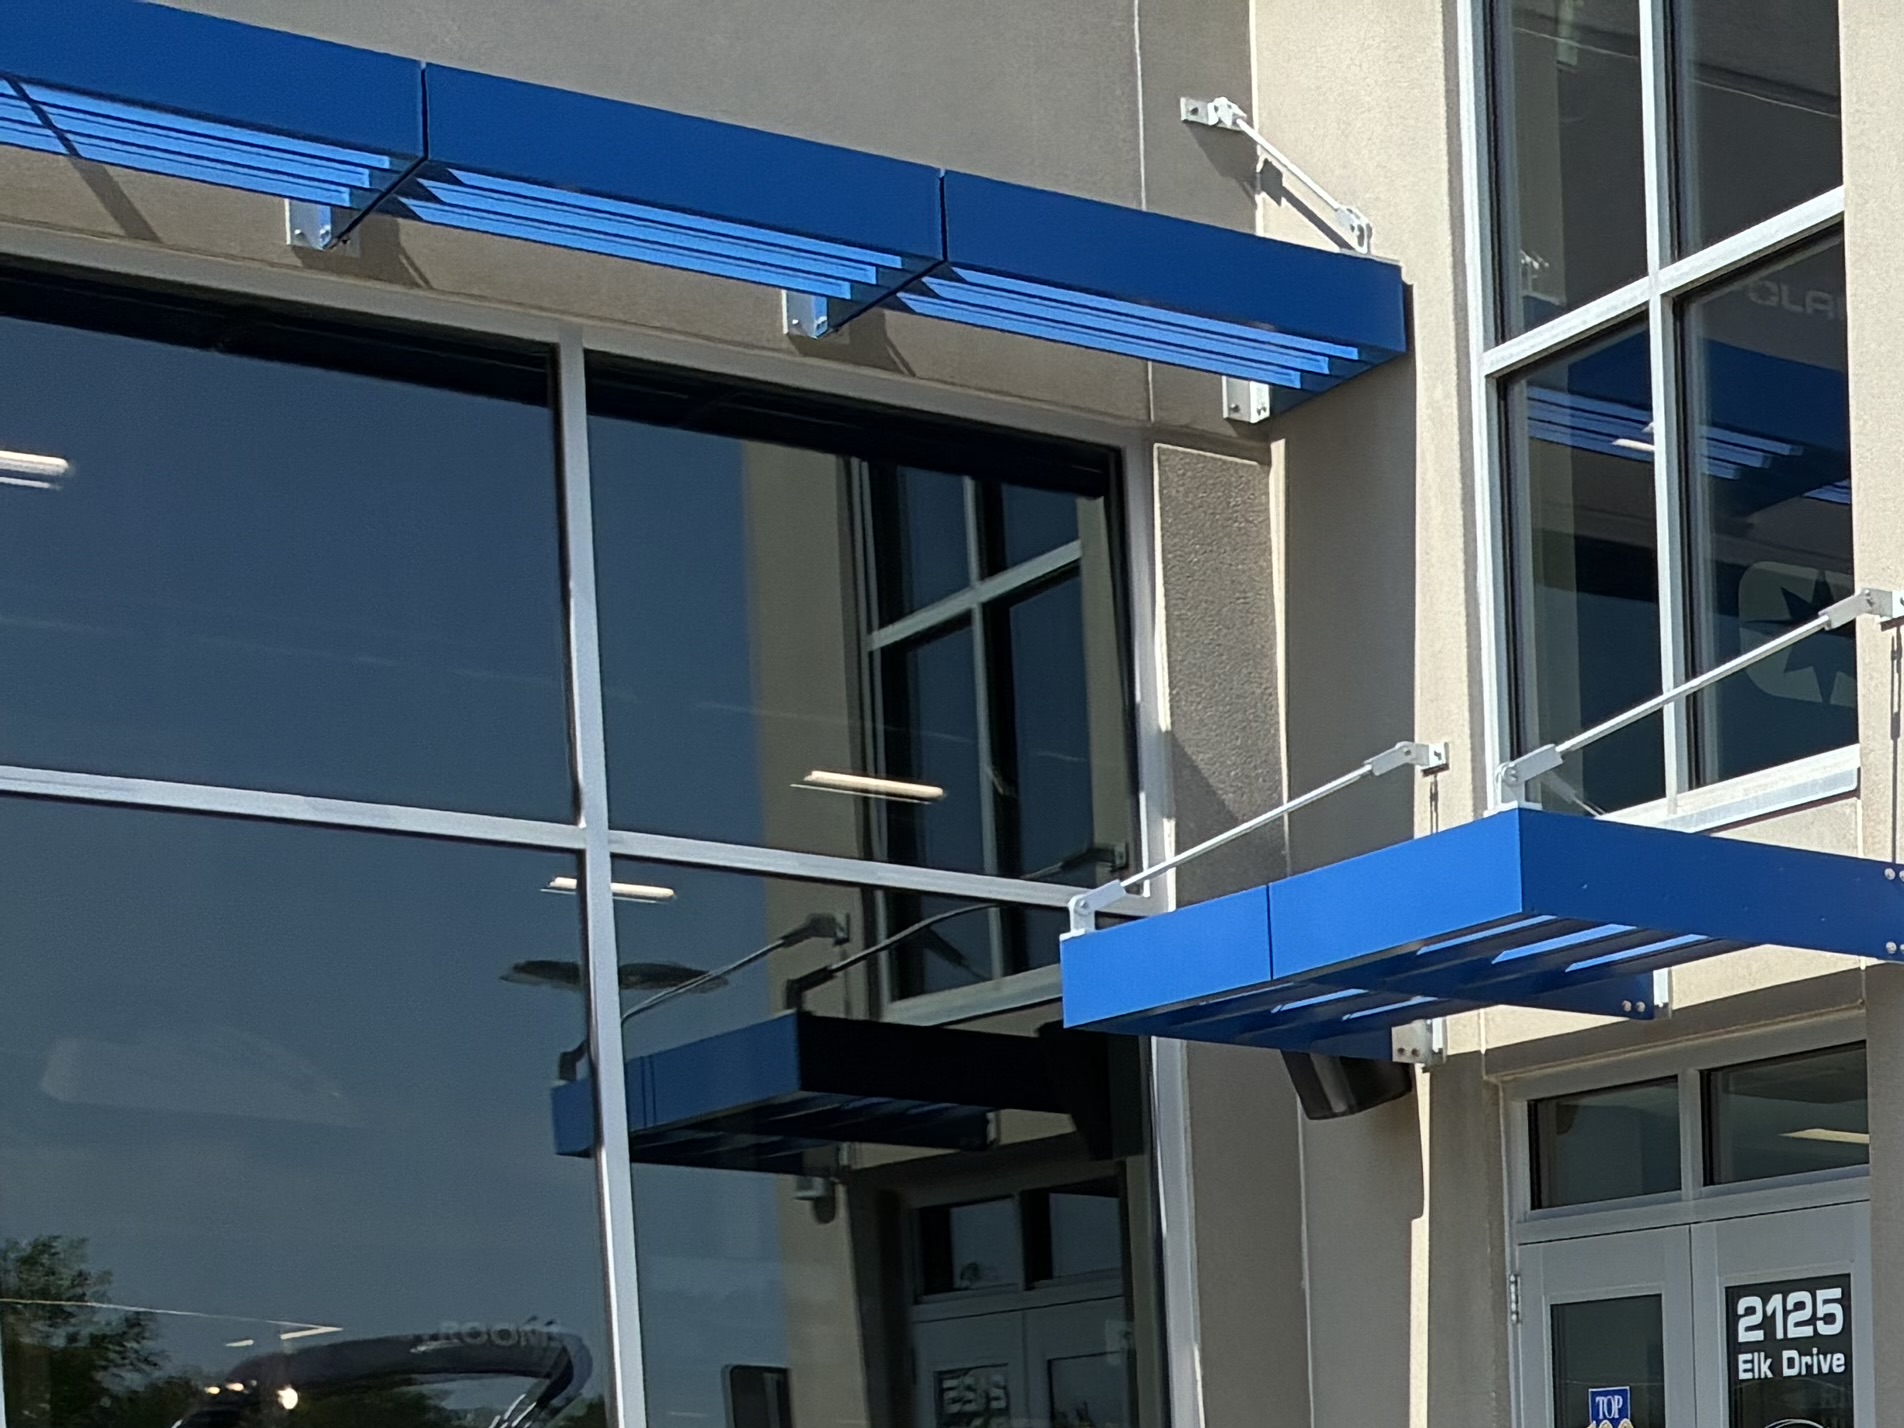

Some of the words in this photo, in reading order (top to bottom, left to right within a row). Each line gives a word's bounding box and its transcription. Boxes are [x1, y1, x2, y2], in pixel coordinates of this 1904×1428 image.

[1737, 1287, 1844, 1343] 2125
[1738, 1352, 1774, 1380] Elk
[1782, 1347, 1846, 1377] Drive
[1595, 1395, 1624, 1419] TOP
